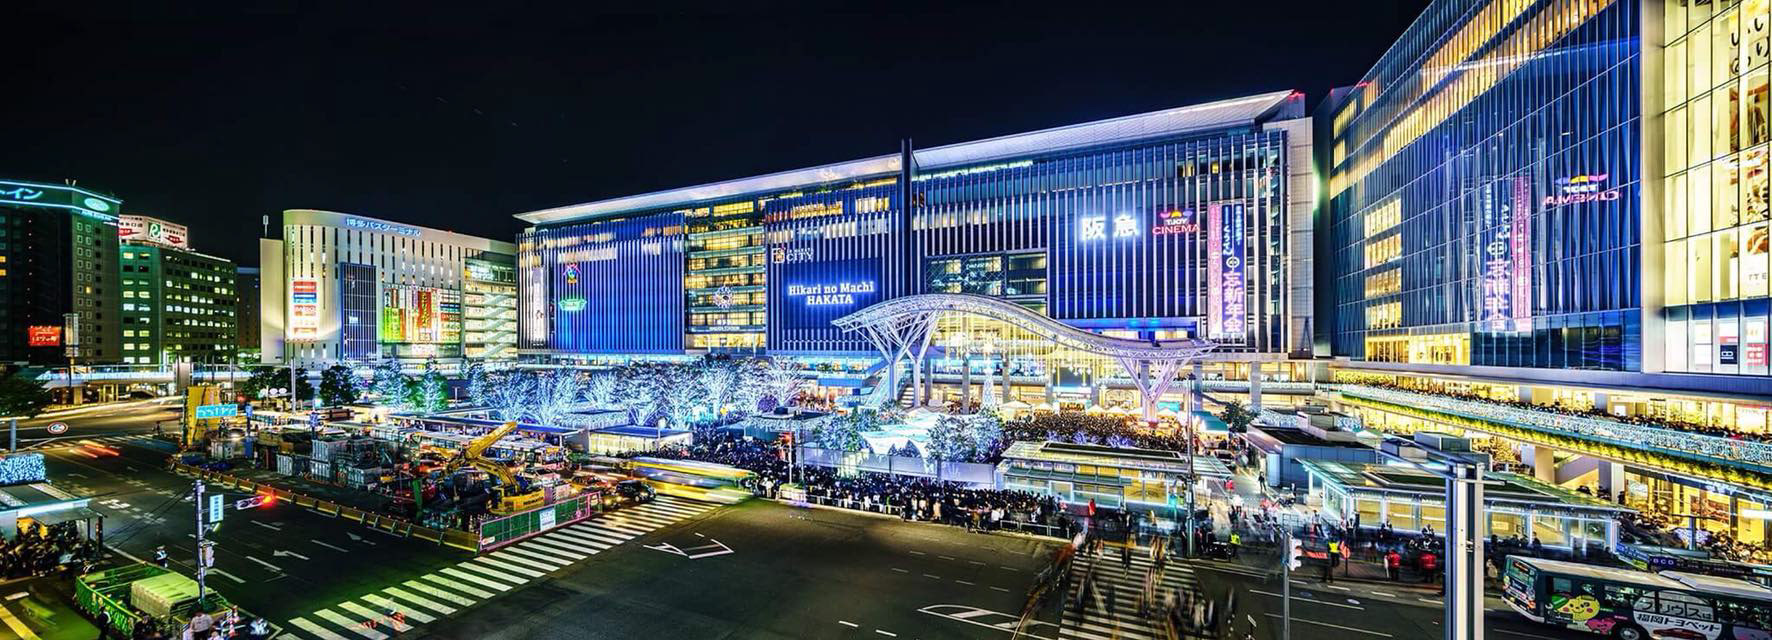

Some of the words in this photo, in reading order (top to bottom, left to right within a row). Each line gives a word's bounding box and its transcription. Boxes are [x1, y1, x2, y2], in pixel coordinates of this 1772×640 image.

[1081, 215, 1139, 240] 阪急
[1152, 224, 1200, 235] CINEMA
[786, 253, 813, 262] CITY
[788, 284, 822, 296] Hikari
[824, 285, 838, 294] no
[840, 281, 875, 293] Machi
[806, 294, 854, 305] HAKATA
